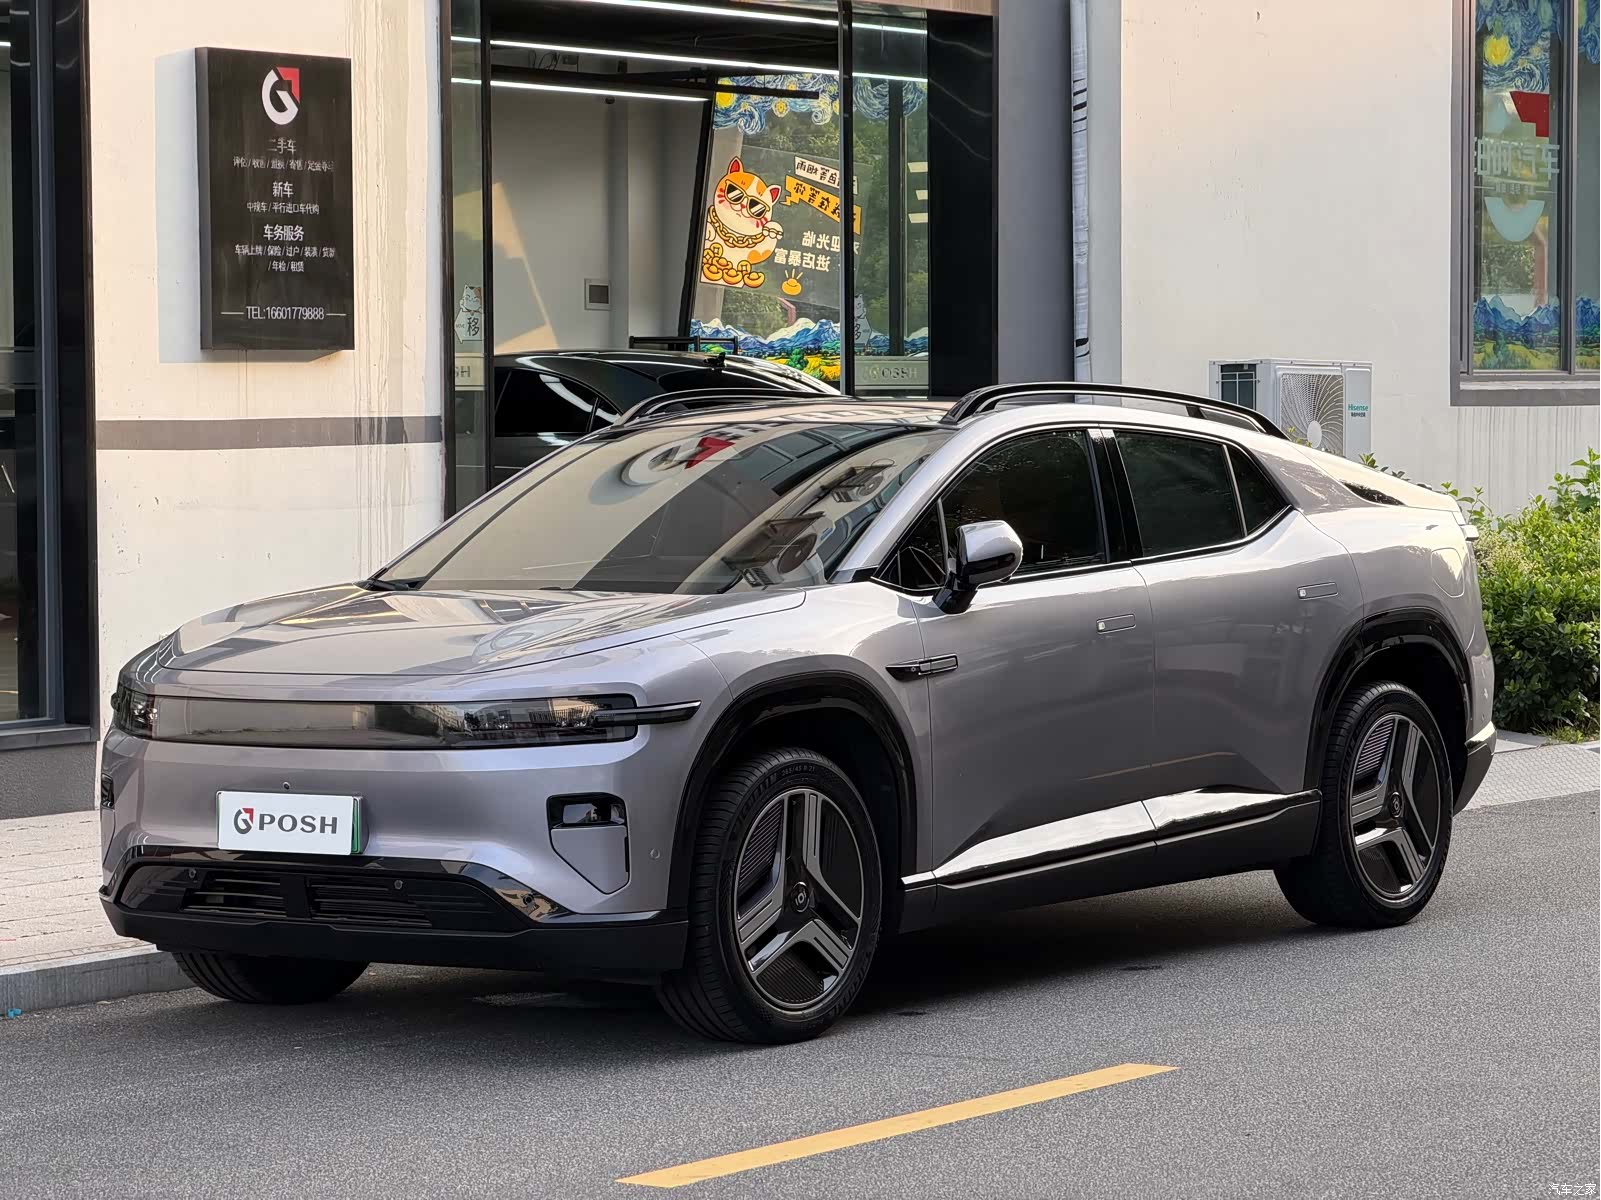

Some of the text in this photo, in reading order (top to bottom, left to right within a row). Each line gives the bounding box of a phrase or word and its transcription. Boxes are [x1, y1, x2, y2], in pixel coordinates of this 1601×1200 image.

[267, 137, 297, 154] 二手车
[272, 181, 294, 198] 新车
[263, 224, 304, 241] 车务服务
[246, 306, 324, 320] TEL:16601779888
[467, 317, 480, 336] 移
[1348, 403, 1369, 412] Hisense
[258, 813, 338, 835] POSH
